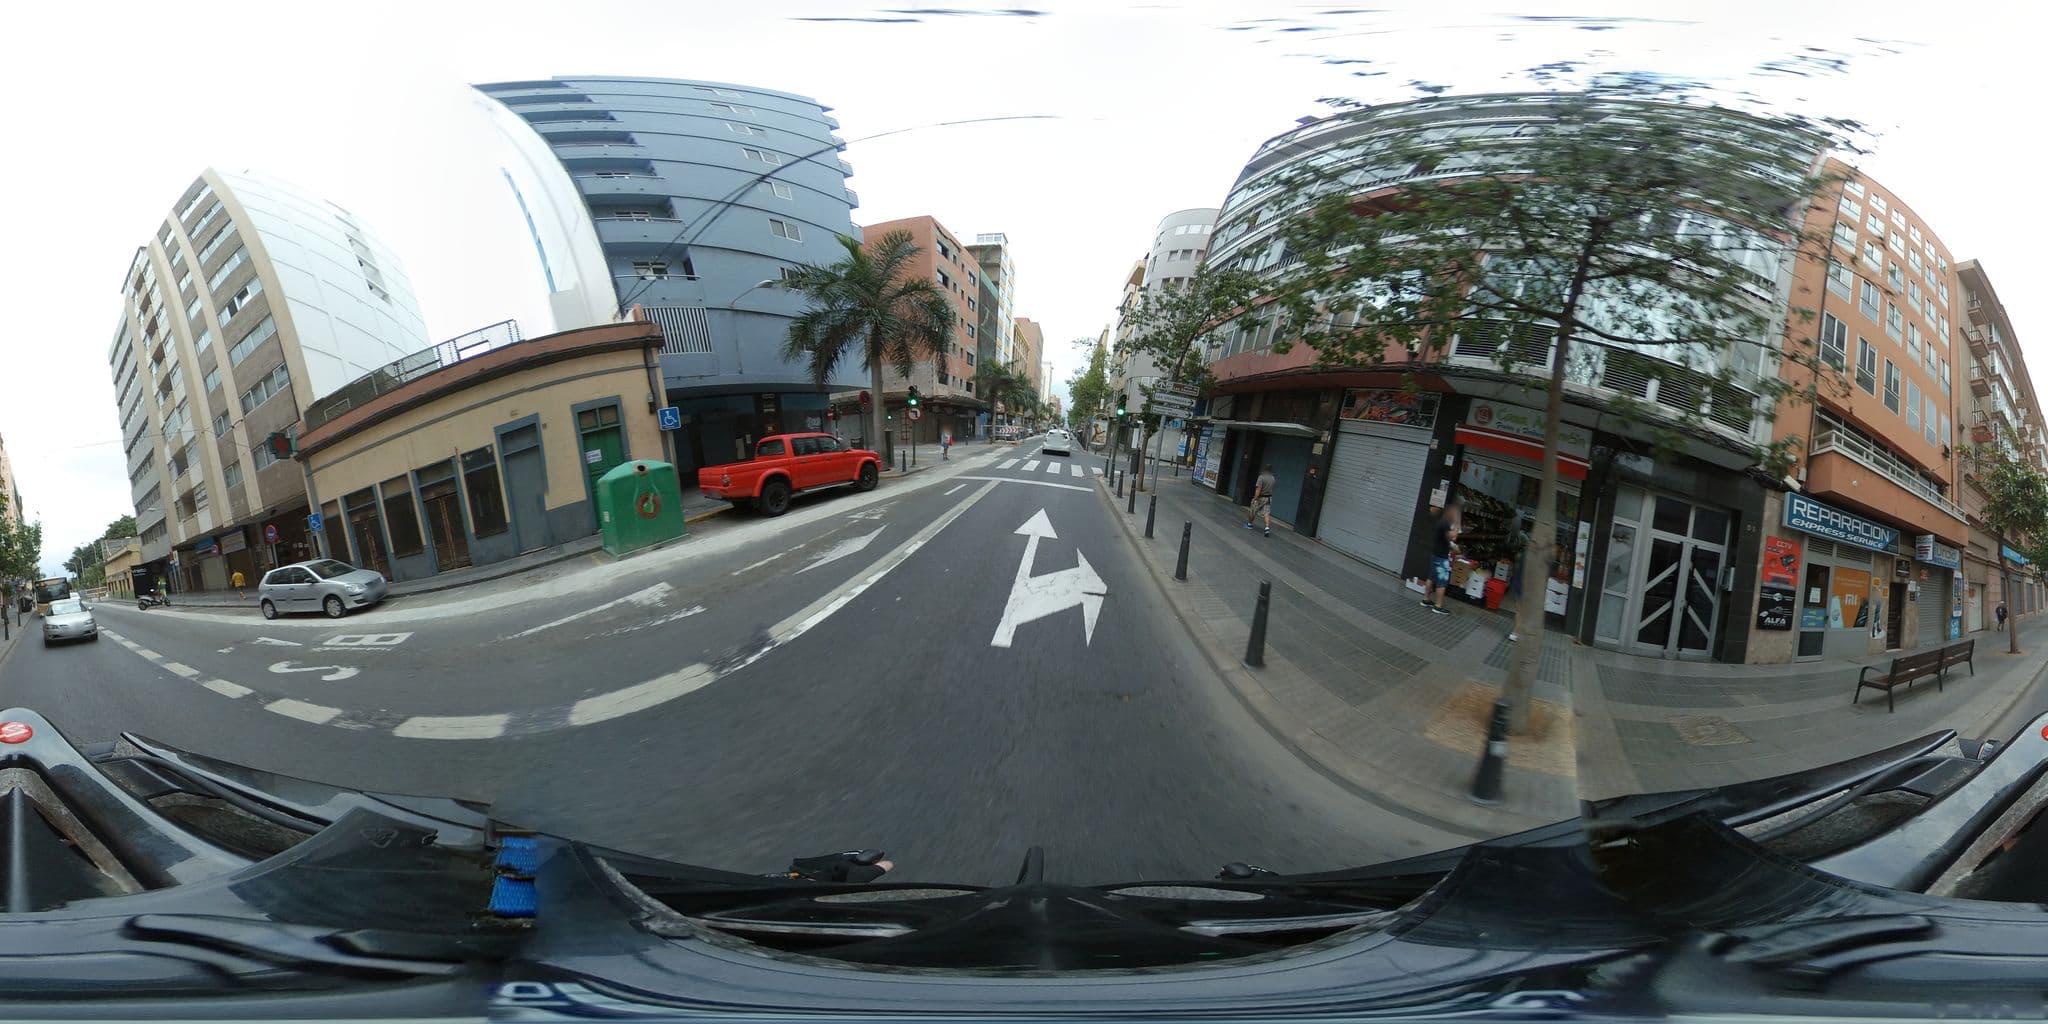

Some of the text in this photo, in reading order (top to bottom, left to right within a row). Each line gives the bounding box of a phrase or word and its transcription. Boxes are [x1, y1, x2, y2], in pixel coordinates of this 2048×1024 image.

[1793, 499, 1889, 542] REPARACION
[1791, 518, 1885, 548] EXPRESS SERVICE
[1776, 540, 1793, 549] CCTV
[1764, 616, 1786, 625] ALFA
